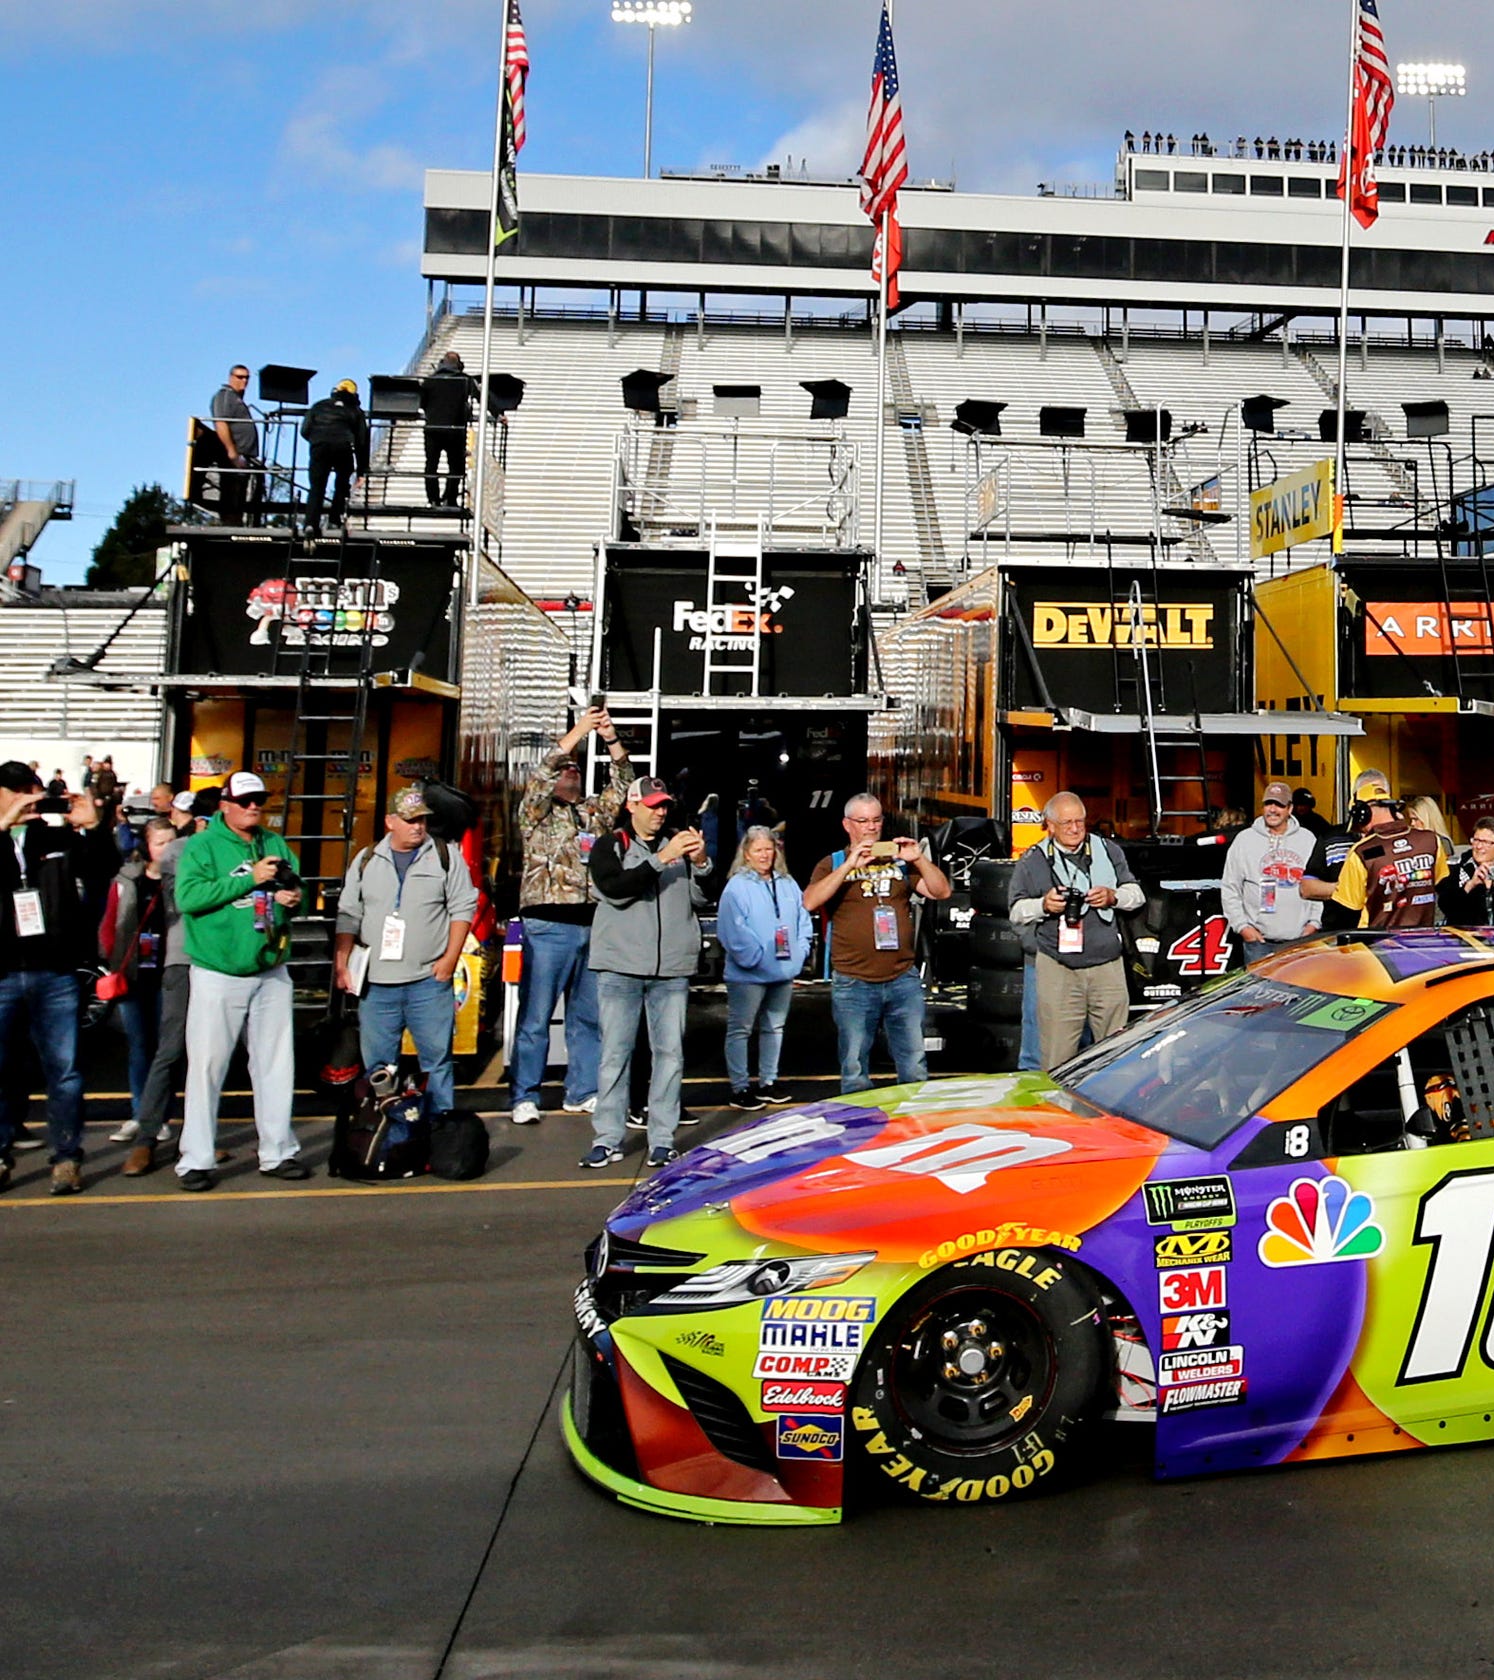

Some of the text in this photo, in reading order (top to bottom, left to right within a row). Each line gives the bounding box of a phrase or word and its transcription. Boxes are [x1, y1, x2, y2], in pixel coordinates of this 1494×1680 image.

[1255, 480, 1321, 541] STANLEY
[809, 790, 834, 808] 11
[1167, 914, 1233, 975] 4
[1143, 988, 1182, 996] OUTBACK
[1174, 1184, 1226, 1197] MONSTER
[1185, 1218, 1223, 1229] PLAYOFFS
[918, 1222, 1083, 1269] GOODYEAR
[954, 1248, 1063, 1291] AGLE
[1157, 1251, 1231, 1268] MECHANIX WEAR
[1163, 1269, 1222, 1310] 3M
[764, 1299, 873, 1321] MOOG
[762, 1323, 860, 1348] MAHLE
[759, 1356, 830, 1374] COMP
[1164, 1350, 1228, 1369] LINCOLN
[1177, 1364, 1234, 1381] WELDERS
[763, 1386, 844, 1407] Edelbrock
[1163, 1380, 1243, 1413] FLOWMASTER
[781, 1432, 840, 1445] SUNOCO
[852, 1406, 1055, 1501] GOODYEAR
